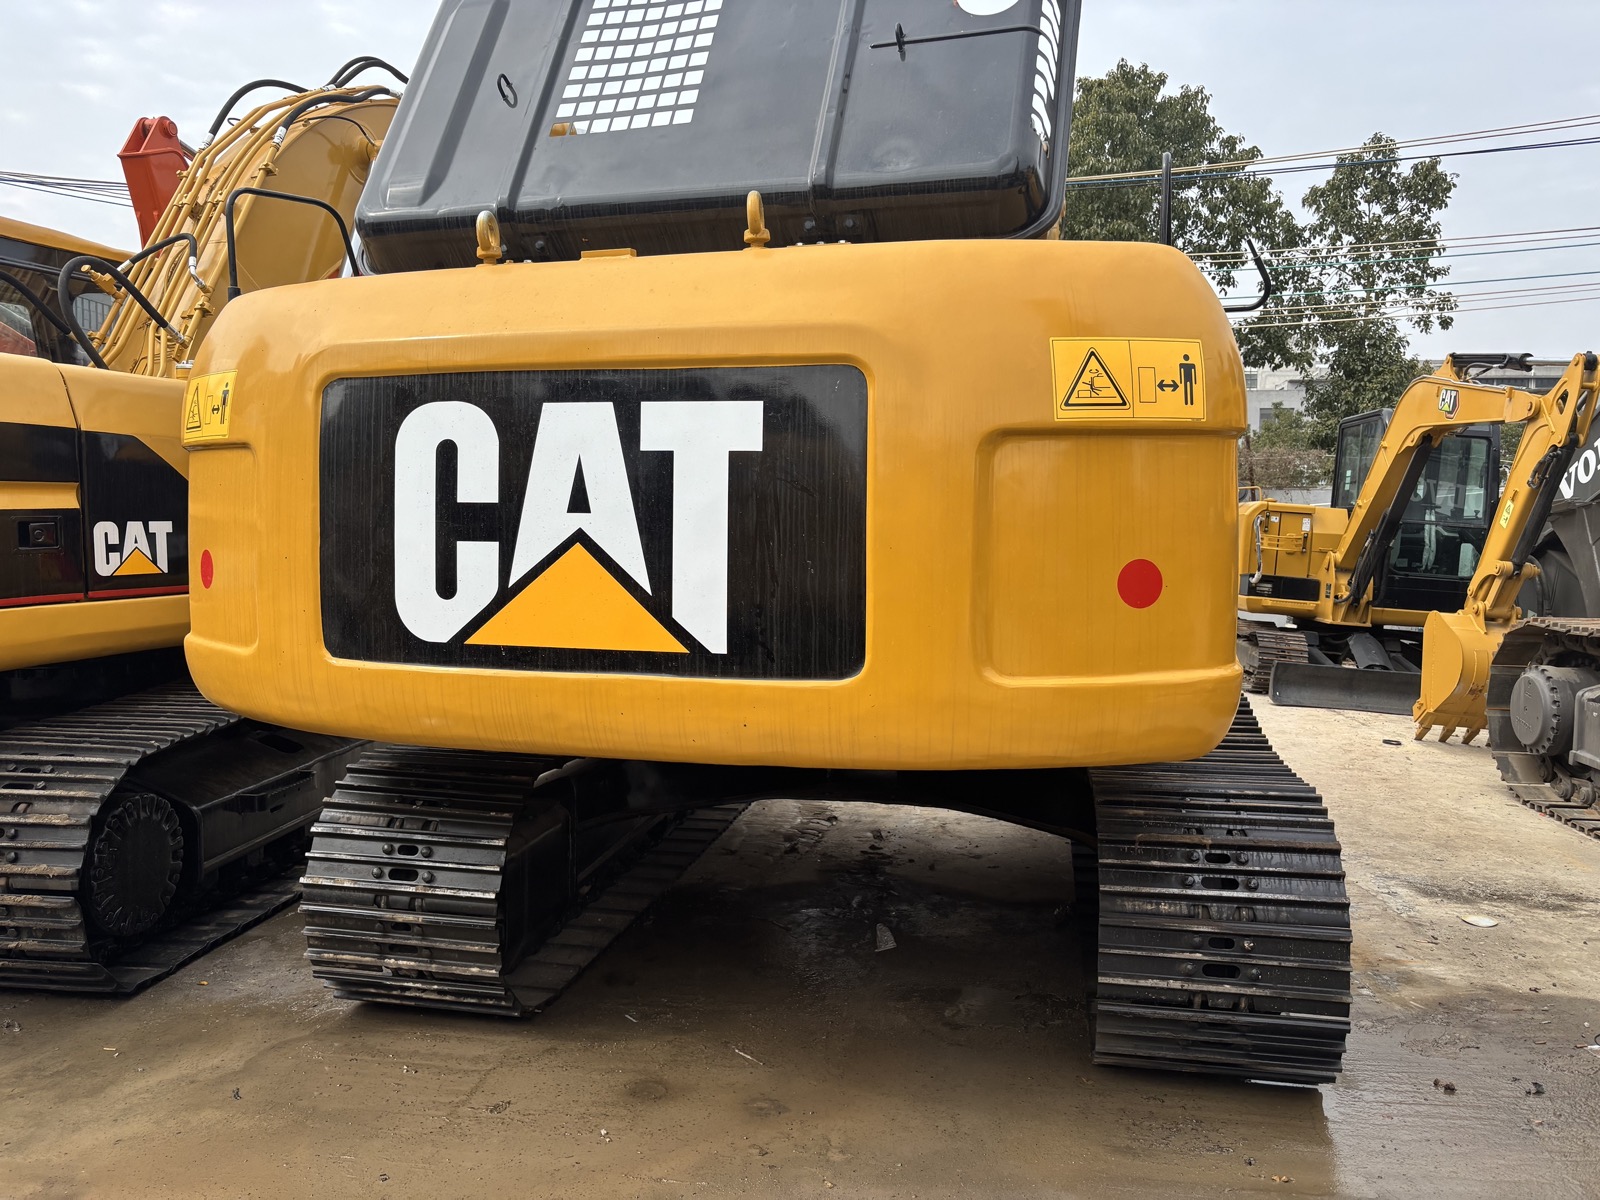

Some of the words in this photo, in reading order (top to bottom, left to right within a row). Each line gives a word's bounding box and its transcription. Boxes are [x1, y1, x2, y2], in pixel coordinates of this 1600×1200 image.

[1438, 389, 1457, 412] CAT
[93, 520, 173, 576] CAT
[394, 401, 764, 654] CAT
